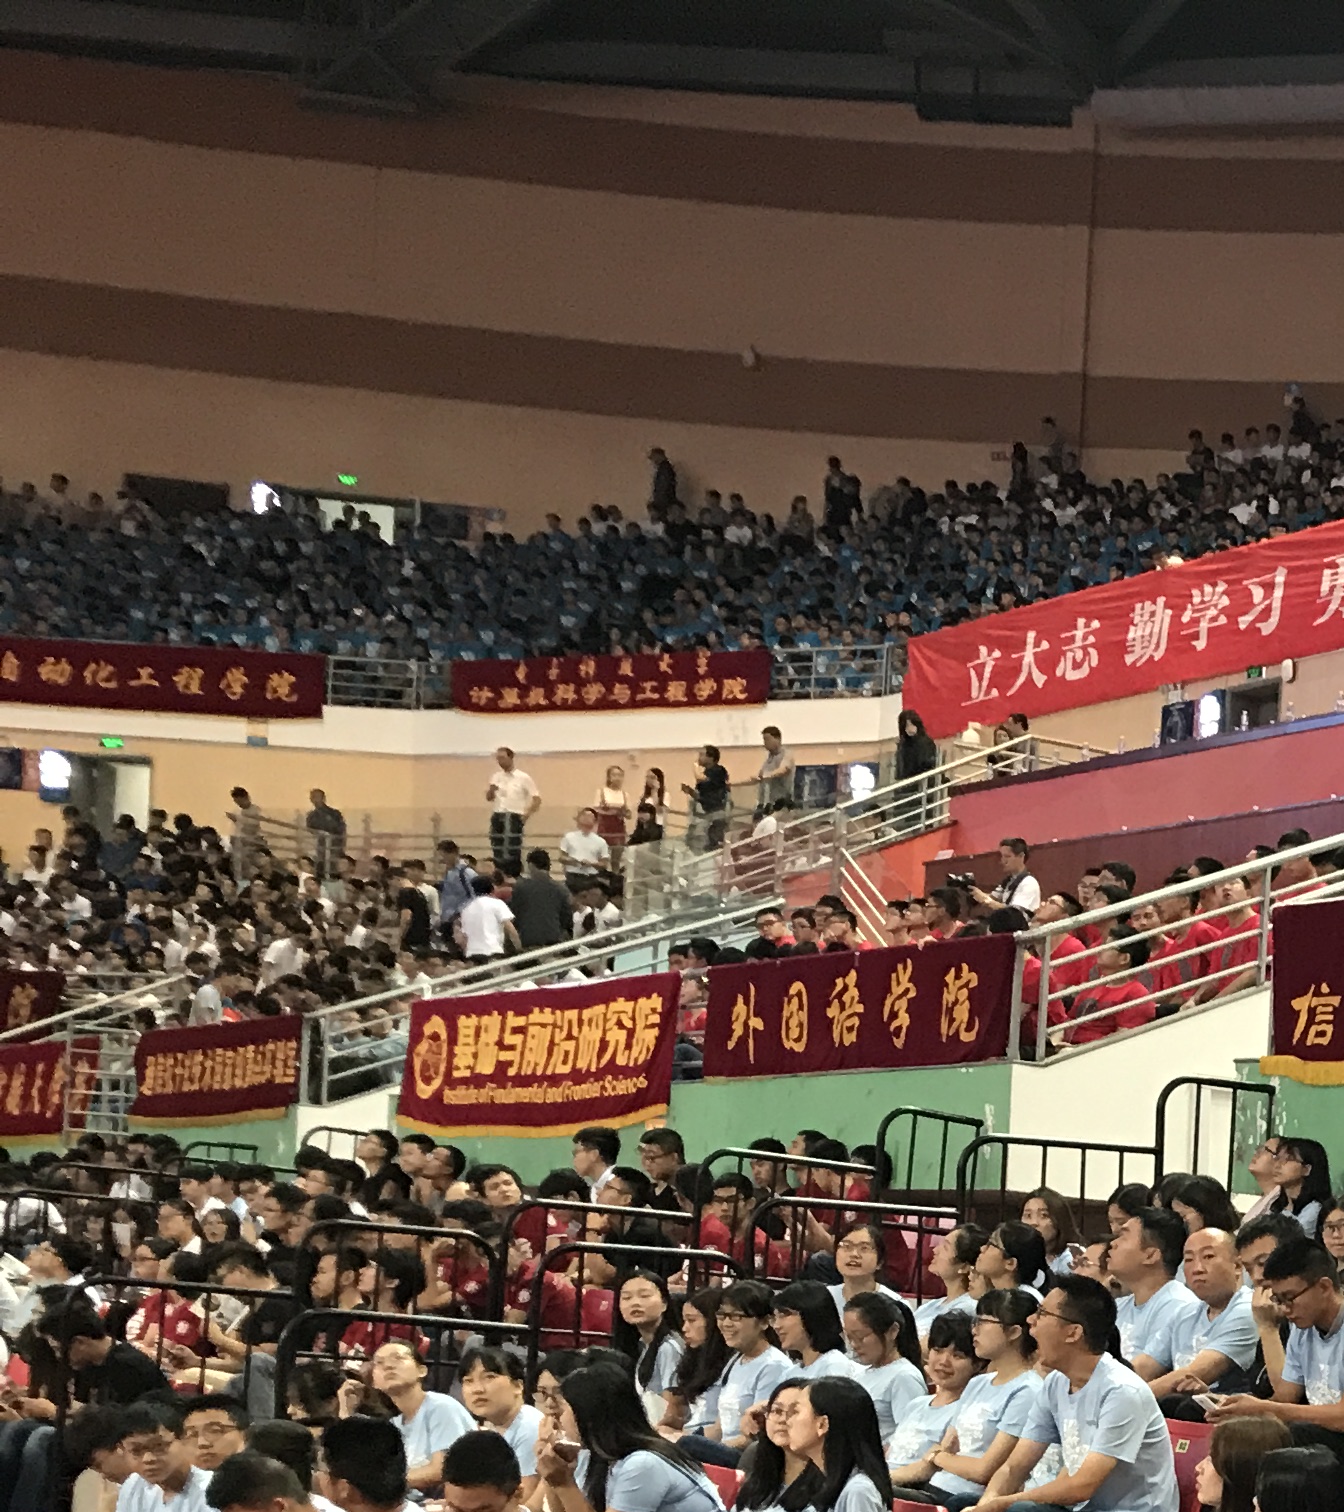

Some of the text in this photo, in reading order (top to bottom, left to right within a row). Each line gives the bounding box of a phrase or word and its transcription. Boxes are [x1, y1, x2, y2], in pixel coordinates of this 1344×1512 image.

[960, 618, 1100, 706] 立大志
[1125, 566, 1288, 666] 勤学习
[452, 993, 663, 1078] 基础与前沿研究院
[727, 960, 979, 1063] 外国语学院
